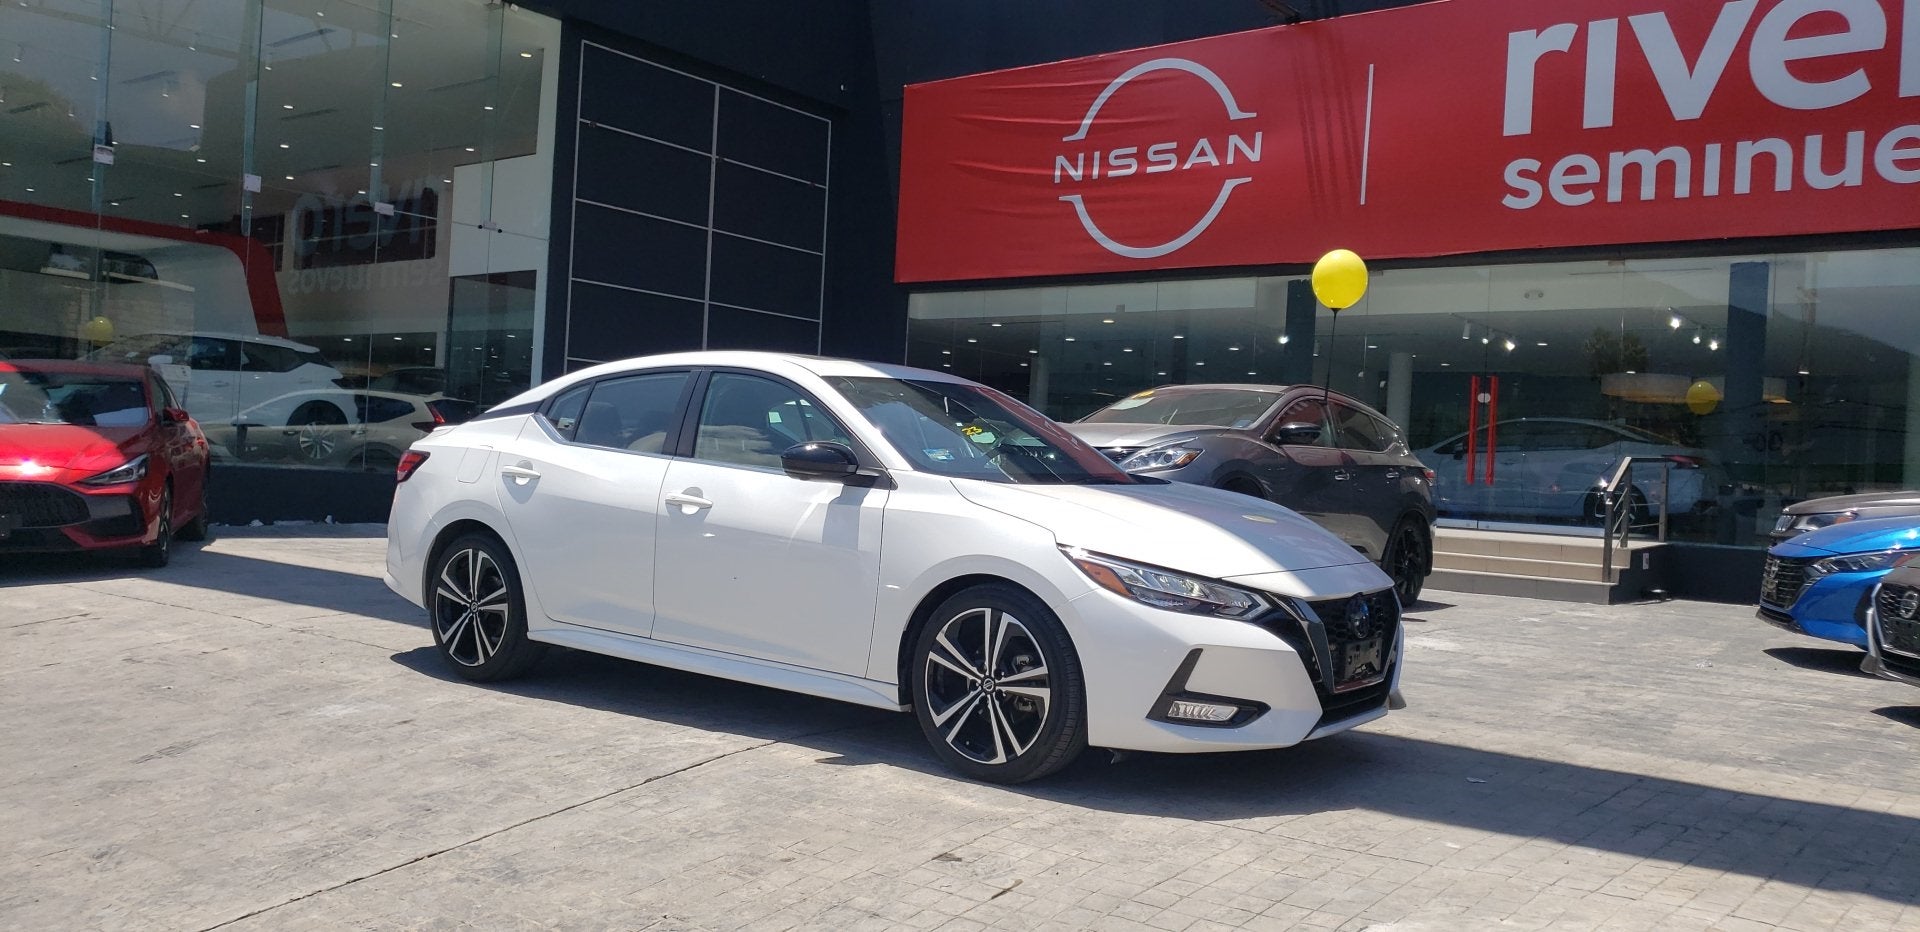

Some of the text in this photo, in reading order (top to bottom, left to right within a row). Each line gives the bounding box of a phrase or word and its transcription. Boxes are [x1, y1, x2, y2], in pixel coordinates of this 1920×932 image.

[1503, 0, 1920, 136] rive
[1054, 132, 1263, 184] NISSAN
[1502, 124, 1920, 210] seminue
